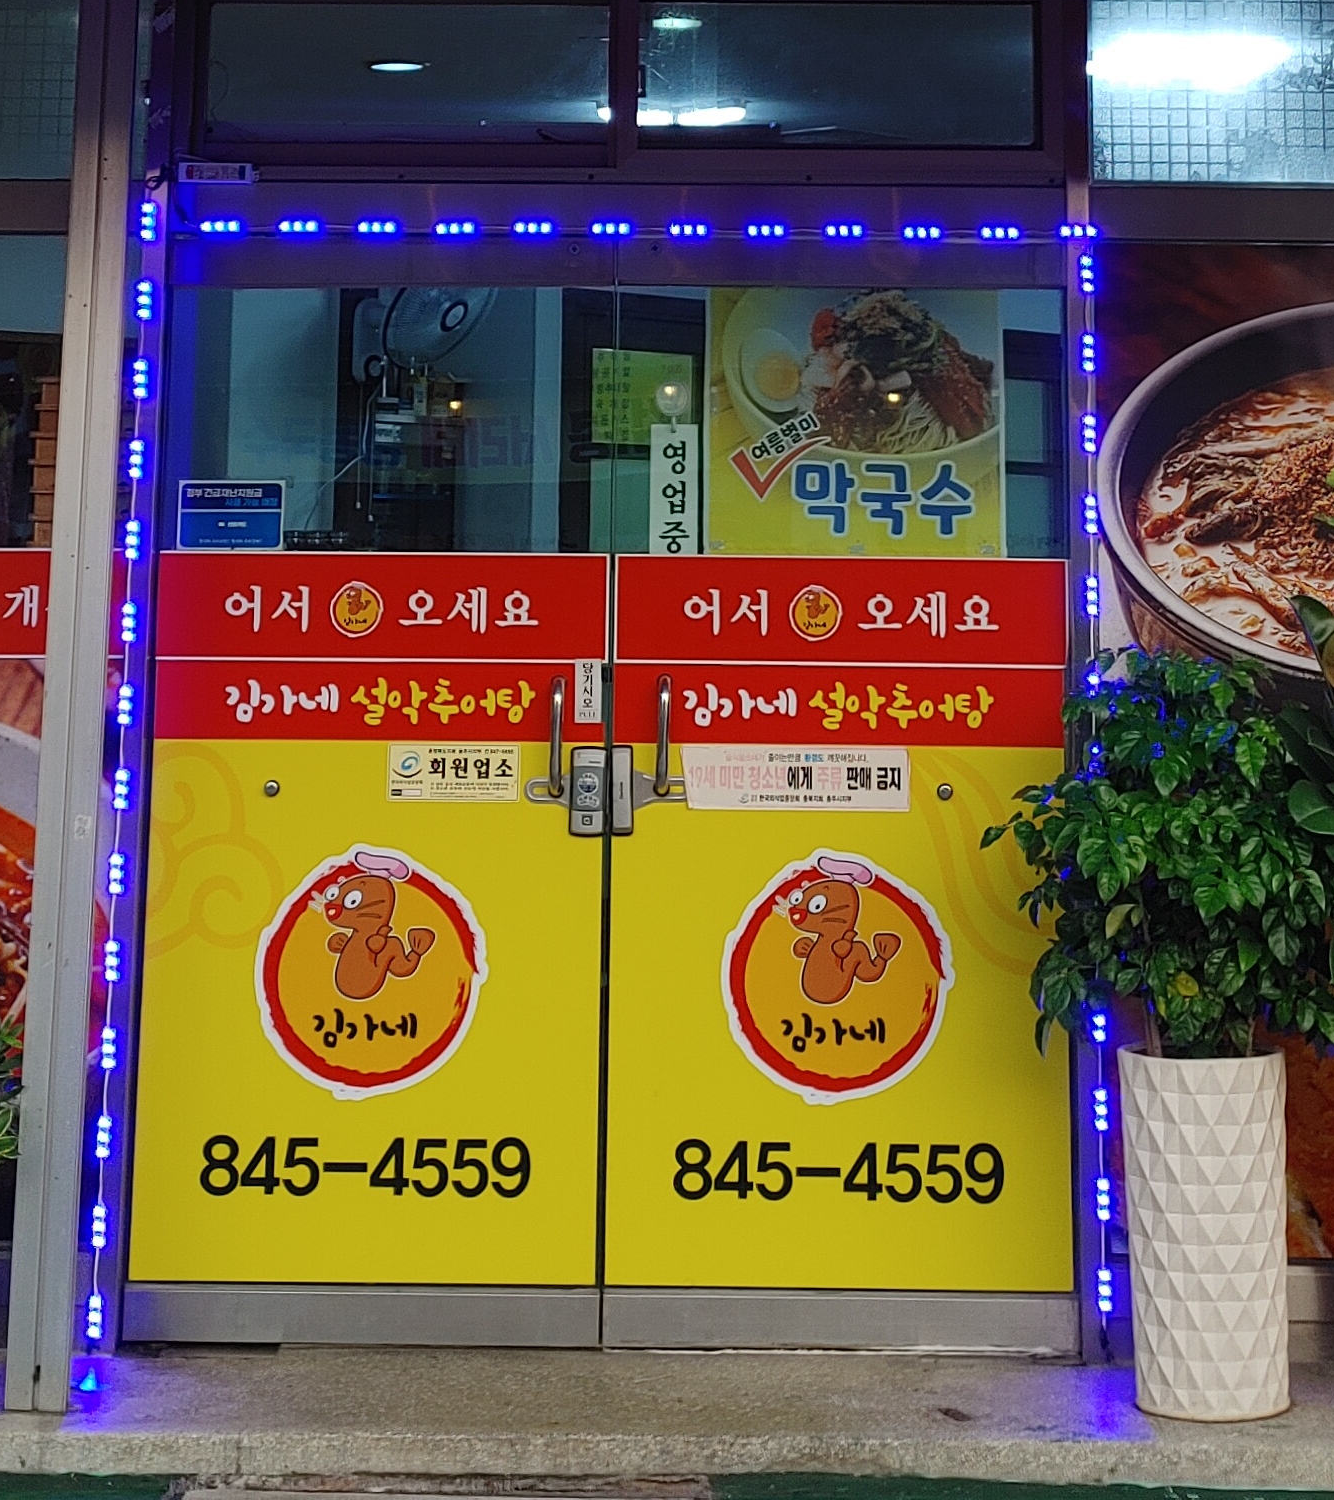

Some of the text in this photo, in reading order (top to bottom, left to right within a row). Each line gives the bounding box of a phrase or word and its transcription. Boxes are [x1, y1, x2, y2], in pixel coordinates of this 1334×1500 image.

[750, 413, 819, 461] 여름별미
[658, 440, 690, 554] 영업중
[795, 462, 973, 535] 막국수
[224, 585, 540, 634] 어서 오세요
[683, 588, 1000, 639] 어서 오세요
[225, 677, 537, 726] 김가네 설악추어탕
[582, 662, 594, 709] 당기시오
[683, 681, 995, 730] 김가네 설악추어탕
[427, 757, 514, 780] 회원업소
[688, 765, 902, 791] 19세 미만 청소년에게 주류 판매 금지
[313, 1008, 418, 1048] 김가네
[780, 1013, 886, 1052] 김가네
[199, 1135, 531, 1198] 845-4559
[673, 1138, 1005, 1204] 845-4559
